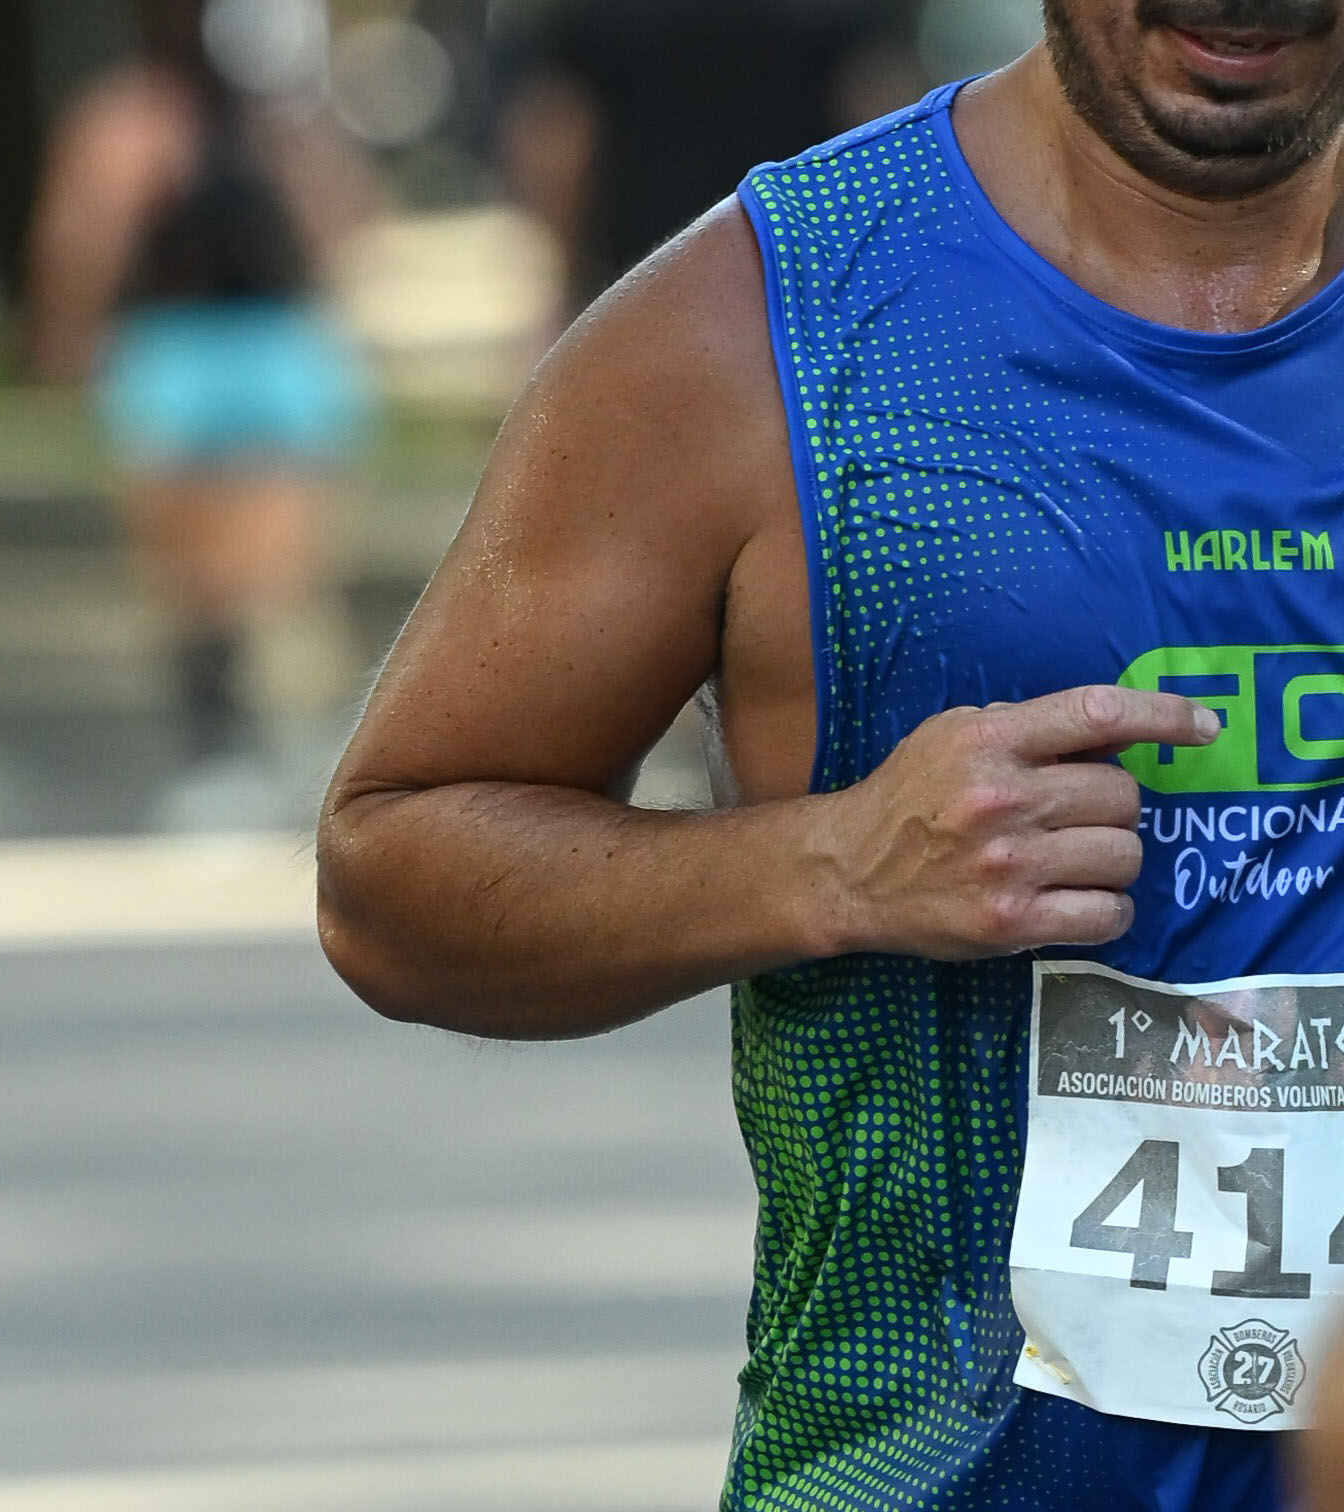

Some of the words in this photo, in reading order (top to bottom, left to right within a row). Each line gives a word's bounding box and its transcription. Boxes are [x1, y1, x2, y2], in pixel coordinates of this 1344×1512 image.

[1165, 529, 1335, 572] HARLEM
[1174, 846, 1335, 910] Outdoor
[1057, 1071, 1166, 1100] ASOCIACIÓN
[1171, 1080, 1272, 1108] BOMBEROS
[1232, 1350, 1275, 1385] 27
